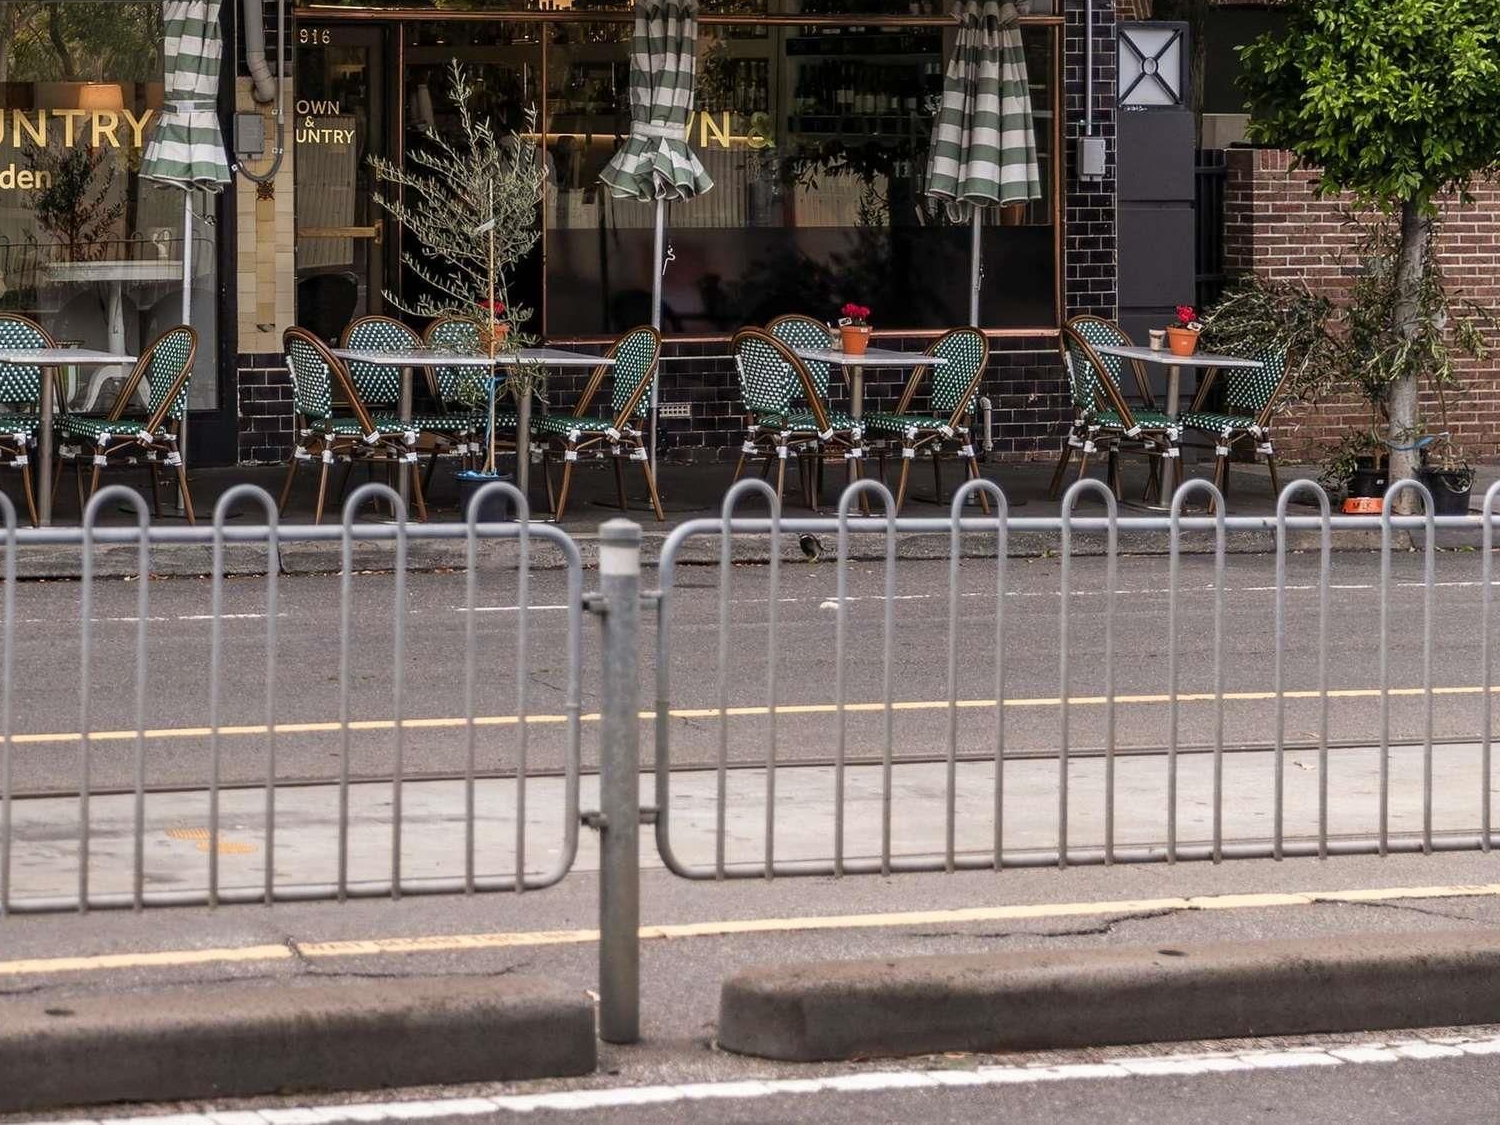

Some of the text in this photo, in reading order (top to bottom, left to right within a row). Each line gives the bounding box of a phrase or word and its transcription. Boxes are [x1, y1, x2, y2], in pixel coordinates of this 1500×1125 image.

[300, 28, 331, 45] 916
[296, 100, 340, 115] OWN
[304, 115, 315, 128] &
[296, 129, 355, 144] UNTRY
